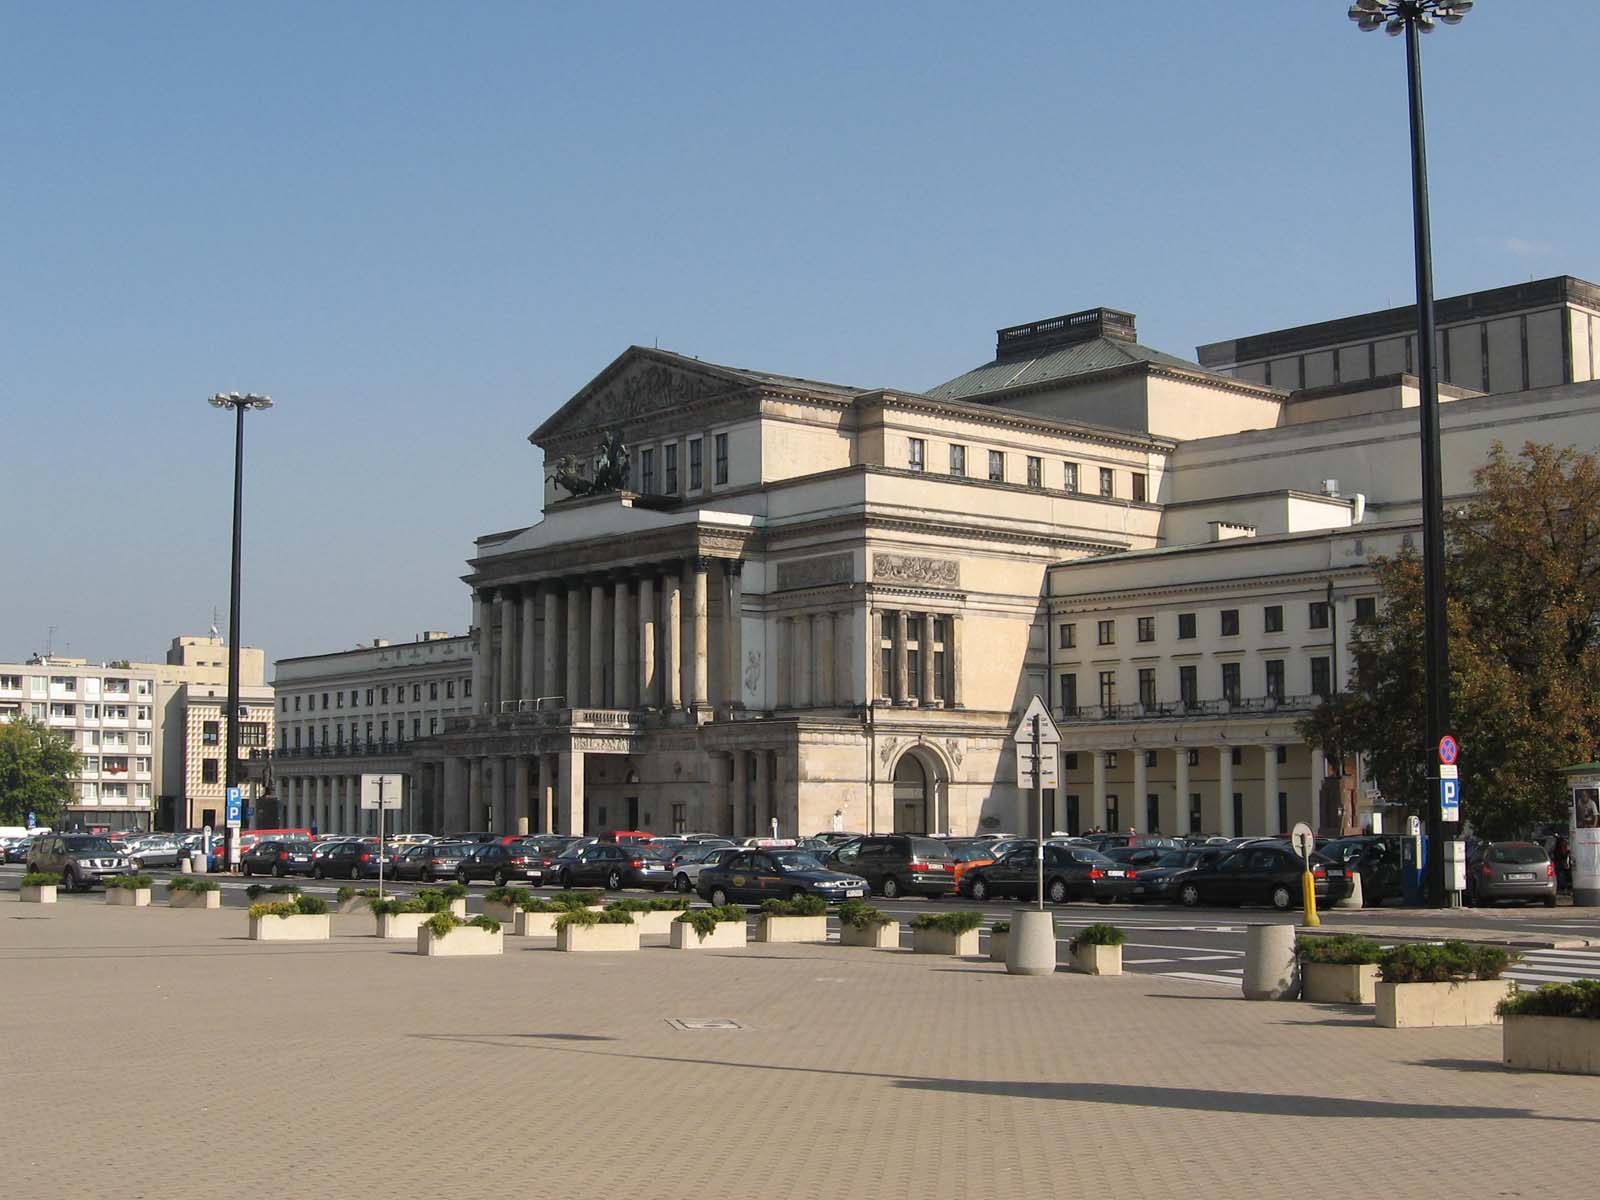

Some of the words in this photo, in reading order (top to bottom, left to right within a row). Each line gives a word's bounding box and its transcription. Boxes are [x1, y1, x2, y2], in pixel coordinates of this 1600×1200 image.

[230, 789, 239, 801] P
[1445, 782, 1455, 804] P
[230, 807, 239, 819] P
